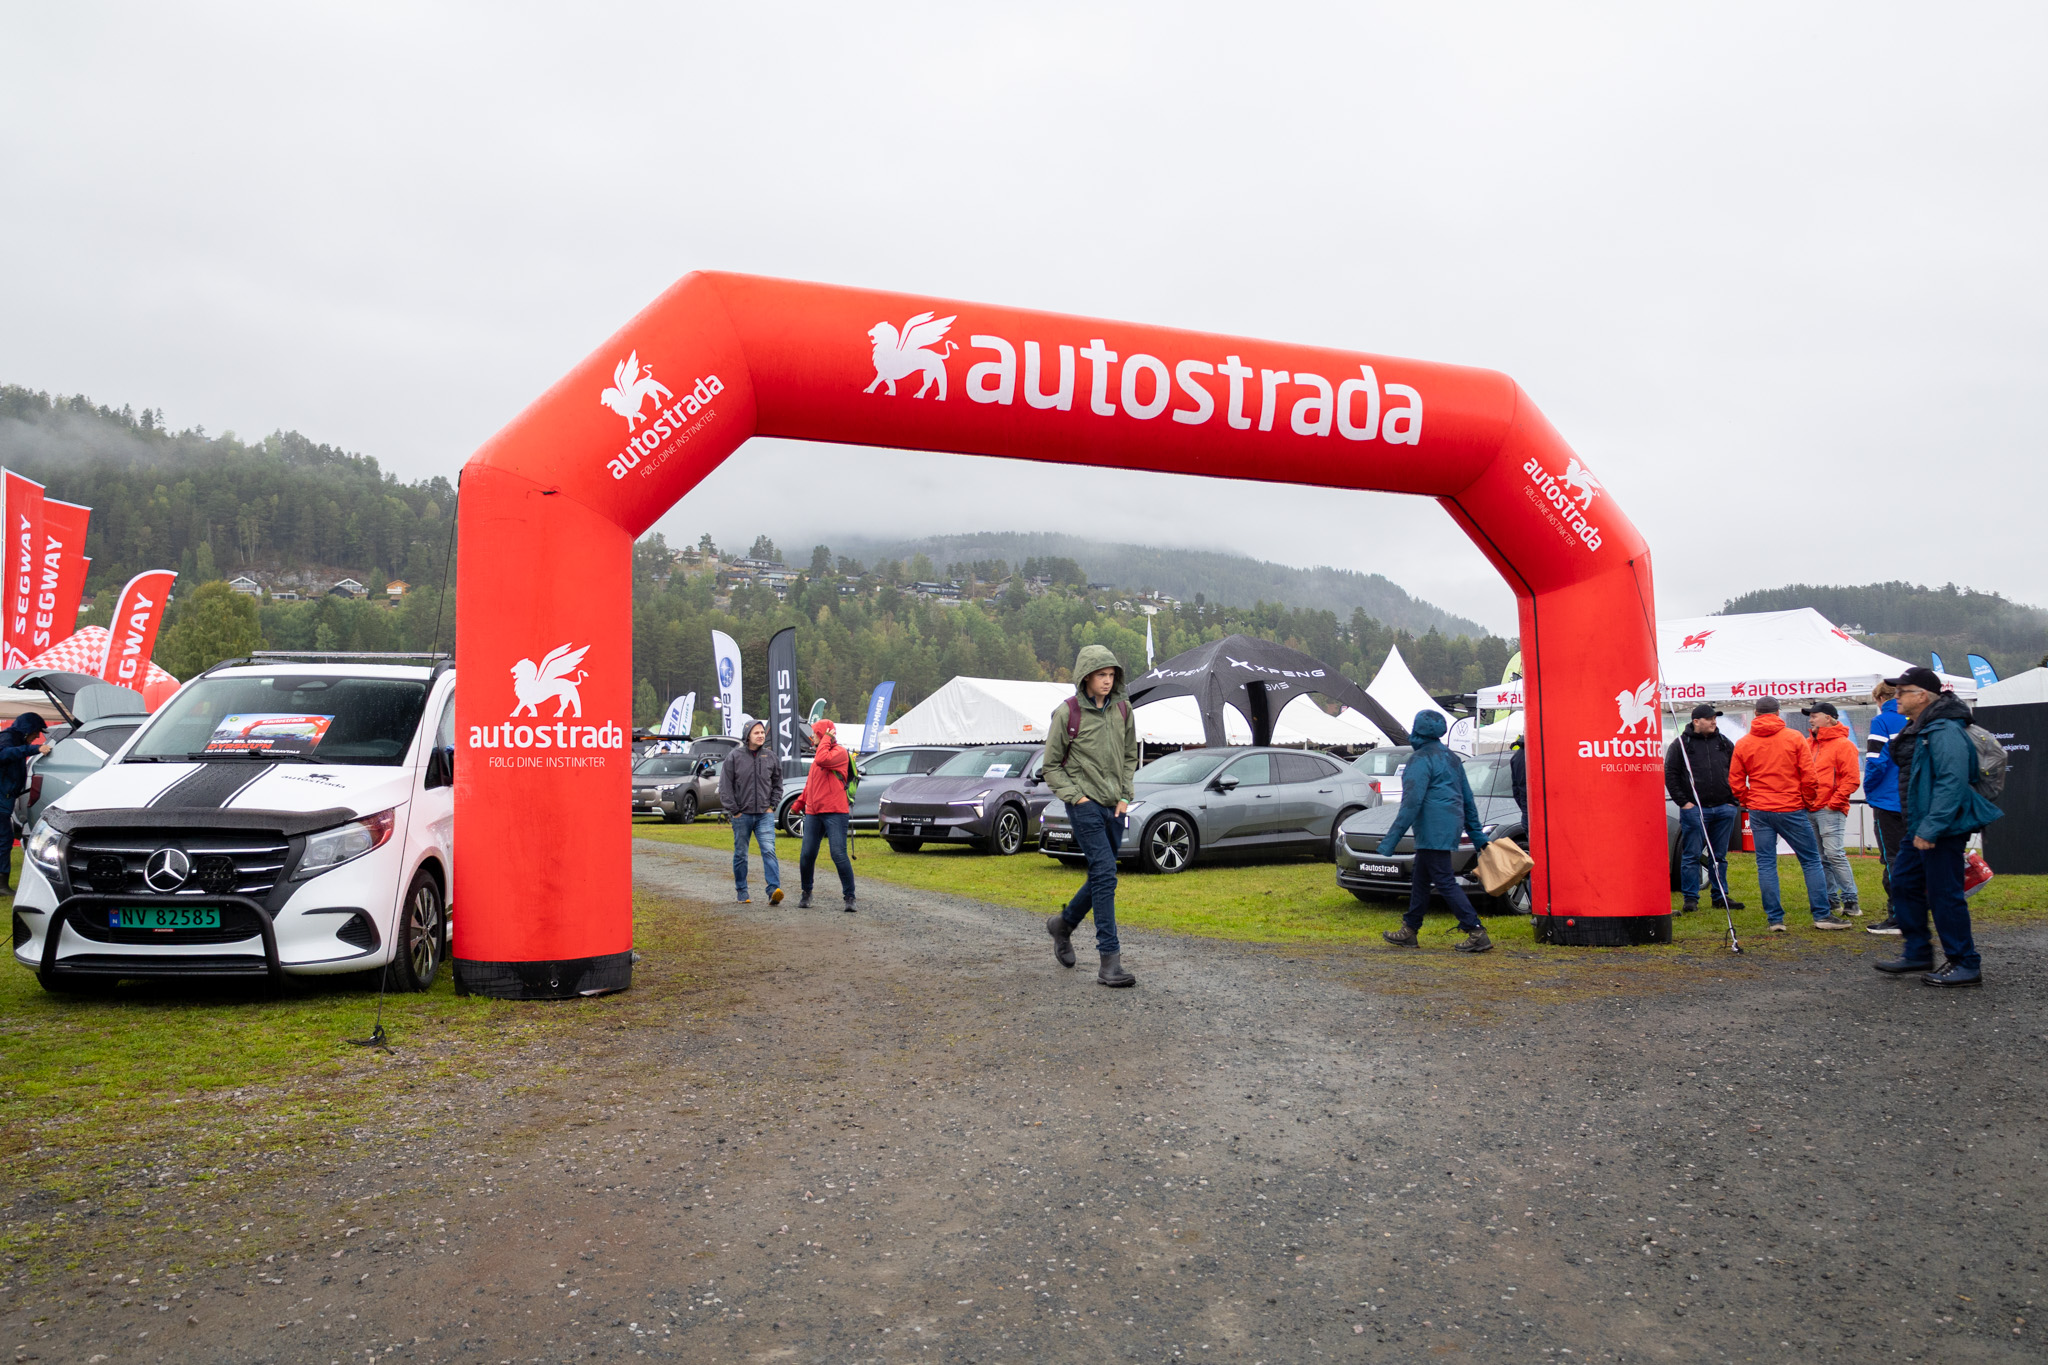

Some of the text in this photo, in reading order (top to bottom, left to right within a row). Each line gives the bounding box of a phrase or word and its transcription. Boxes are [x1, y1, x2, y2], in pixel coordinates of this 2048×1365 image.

[965, 333, 1424, 447] autostrada
[606, 374, 726, 481] autostrada
[639, 408, 718, 480] FØLG DINE INSTINKTER
[1522, 456, 1603, 553] autostrada
[15, 513, 32, 635] SEGWAY
[33, 534, 63, 648] SEGWAY
[116, 592, 154, 689] EGWAY
[1253, 664, 1326, 678] XPENG
[1749, 678, 1848, 697] autostrada
[469, 719, 623, 750] autostrada
[777, 669, 793, 762] KARS
[867, 696, 886, 750] VELKOMMEN
[281, 775, 346, 789] autostrada
[489, 756, 606, 768] FØLG DINE INSTINKTER
[1601, 763, 1622, 772] FØLG
[1624, 763, 1641, 772] DINE
[1365, 864, 1399, 873] autostrada
[122, 909, 216, 926] NV 82585
